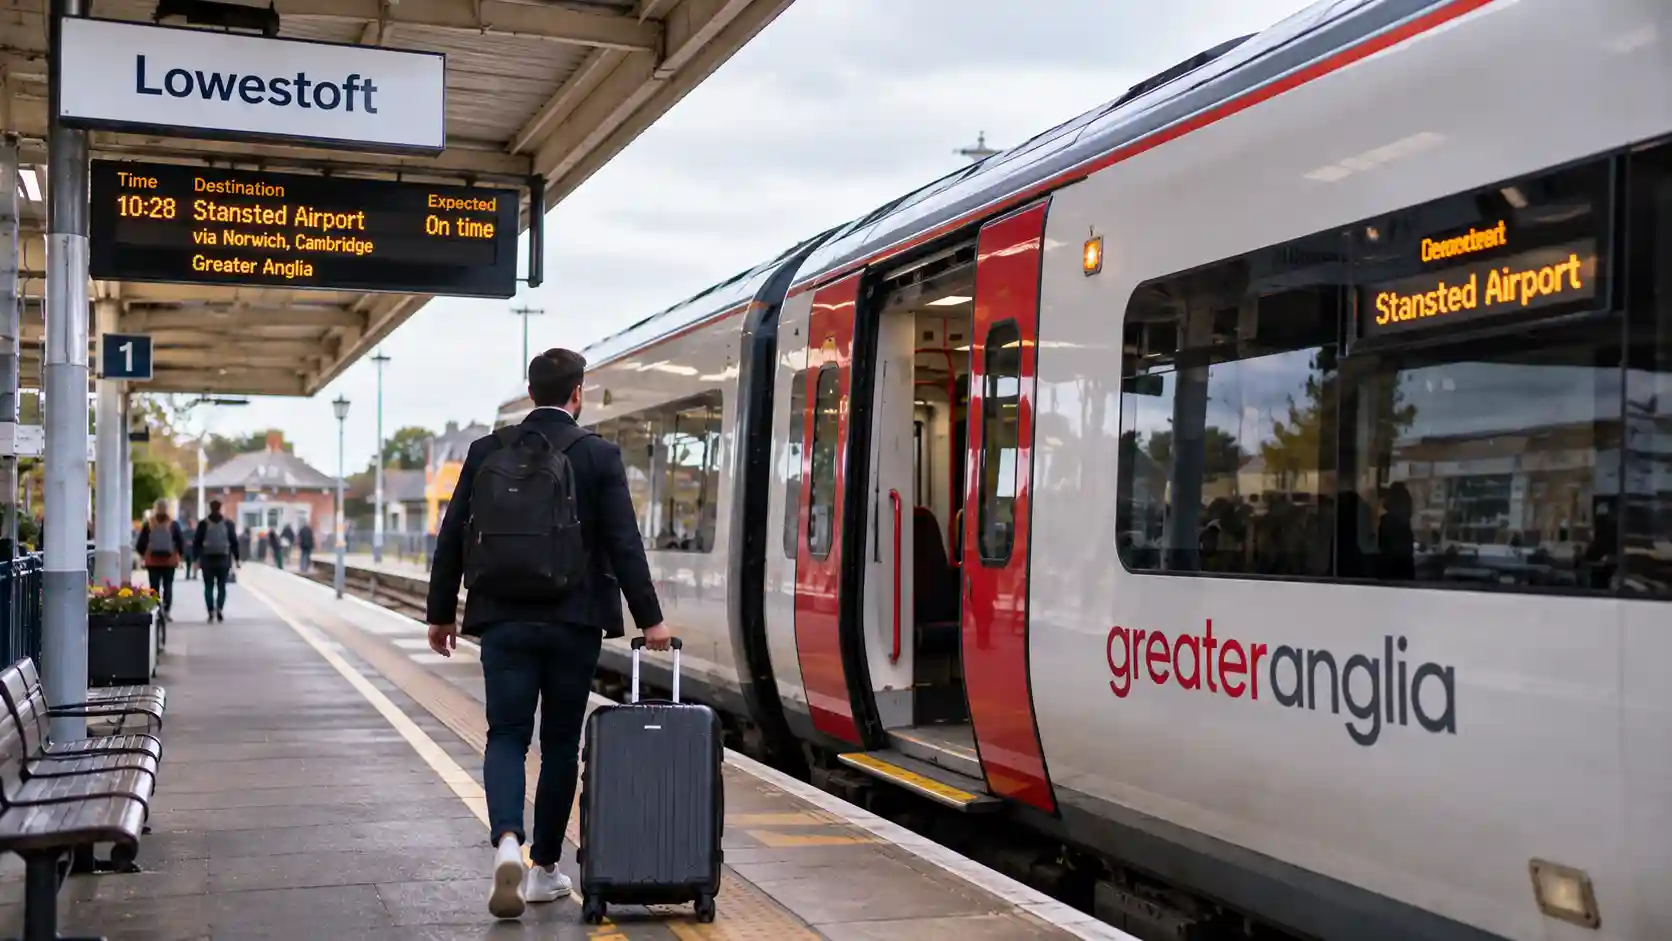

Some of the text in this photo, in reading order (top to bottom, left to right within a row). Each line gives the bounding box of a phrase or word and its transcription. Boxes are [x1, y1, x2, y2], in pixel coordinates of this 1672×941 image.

[136, 54, 378, 114] Lowestoft
[118, 171, 157, 189] Time
[194, 177, 285, 197] Destination
[118, 195, 176, 219] 10:28
[428, 194, 497, 212] Expected
[193, 199, 365, 233] Stansted Airport
[426, 214, 495, 239] On time
[193, 229, 374, 256] via Norwich, Cambridge
[192, 254, 314, 279] Greater Anglia
[1375, 253, 1582, 325] Stansted Airport
[119, 341, 133, 372] 1
